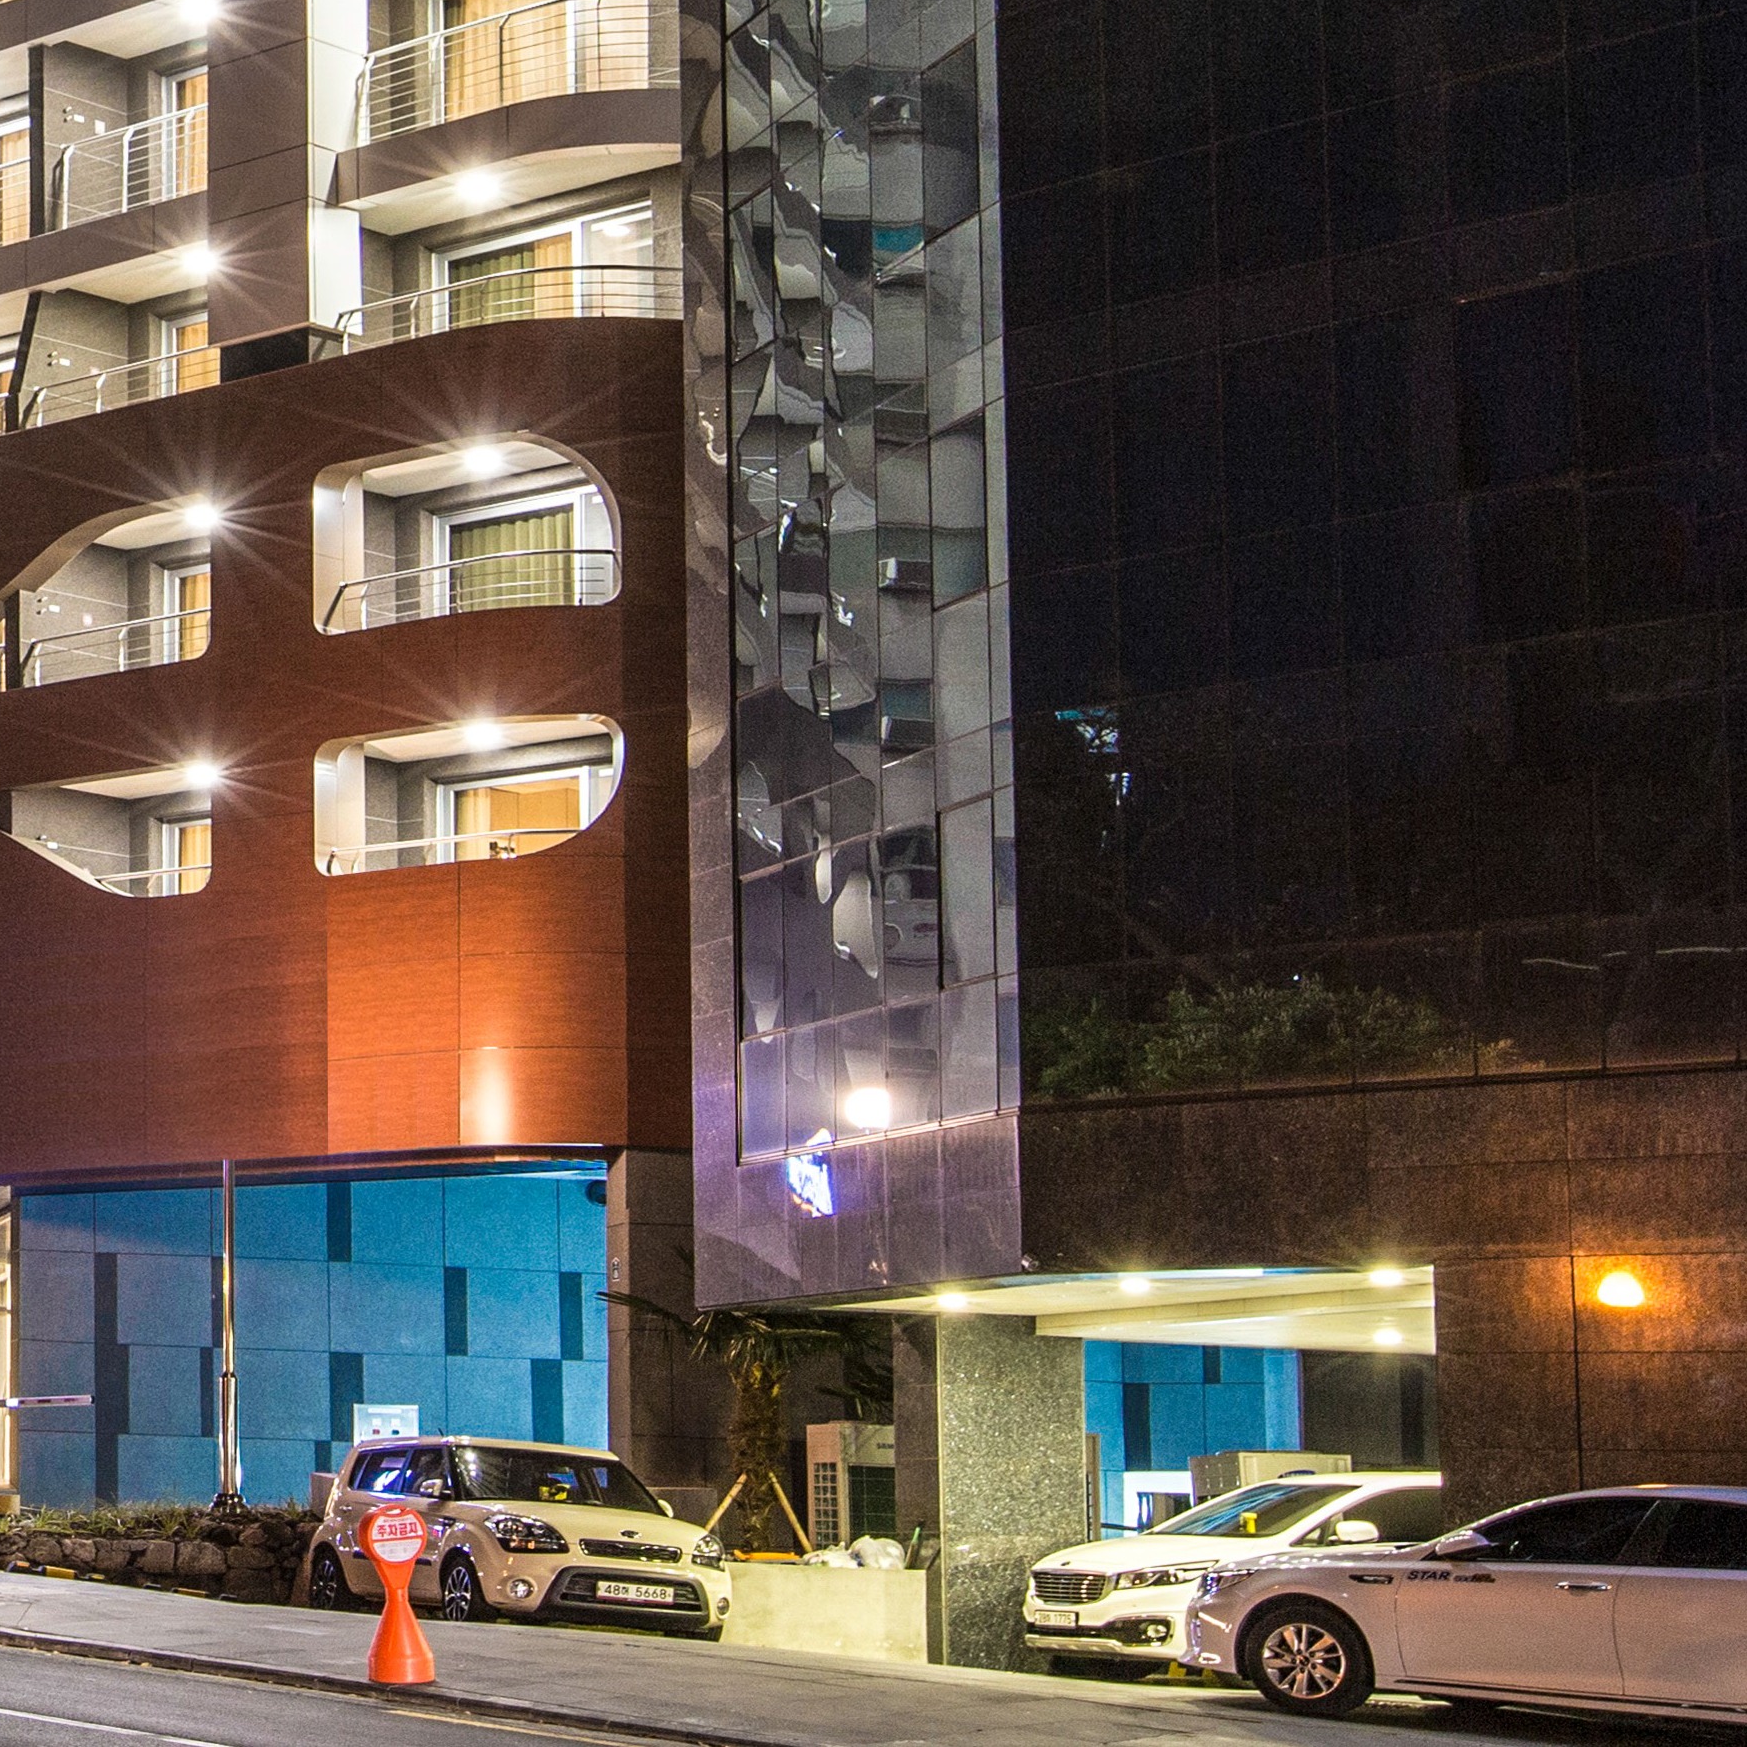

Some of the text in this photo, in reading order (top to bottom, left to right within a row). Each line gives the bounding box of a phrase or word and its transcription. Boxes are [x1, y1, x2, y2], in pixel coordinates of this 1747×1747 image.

[376, 1521, 419, 1537] 주차금지
[1407, 1570, 1451, 1581] STAR
[635, 1587, 668, 1600] 5668
